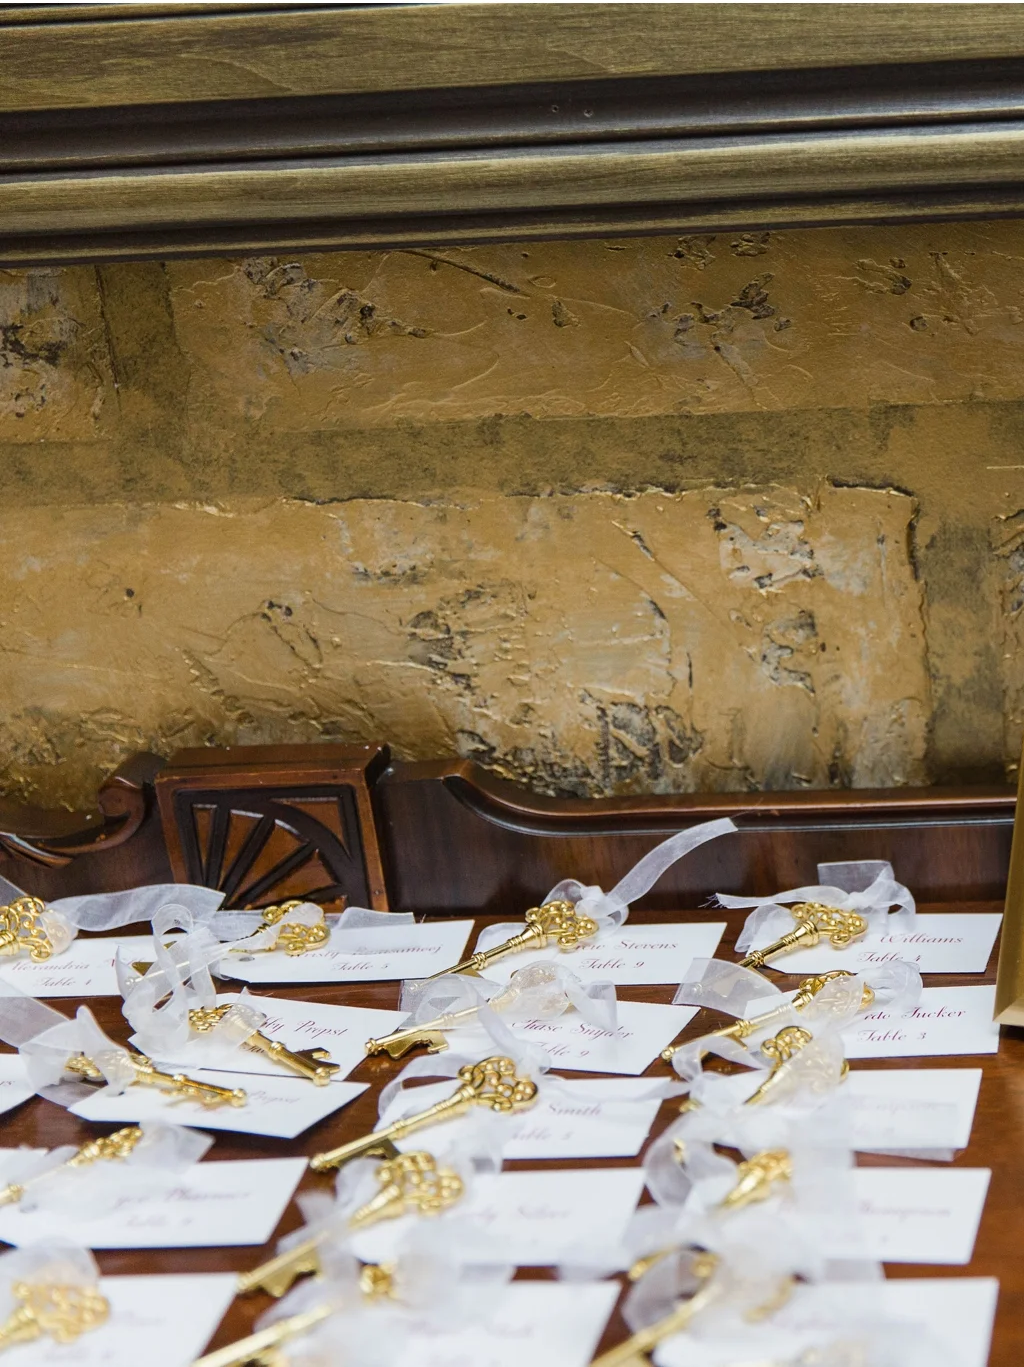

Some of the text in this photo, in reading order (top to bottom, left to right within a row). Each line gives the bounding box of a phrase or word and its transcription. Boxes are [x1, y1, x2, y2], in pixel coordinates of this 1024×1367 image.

[614, 938, 680, 951] Stevens
[880, 932, 964, 944] Williams
[857, 951, 904, 963] Table
[332, 961, 375, 972] Table
[578, 958, 645, 970] Table 9
[35, 976, 76, 988] Table
[900, 1005, 967, 1020] Tucker
[293, 1019, 349, 1040] Propst
[570, 1022, 635, 1041] Snyder
[857, 1028, 928, 1042] Table 3
[547, 1101, 603, 1116] Smith
